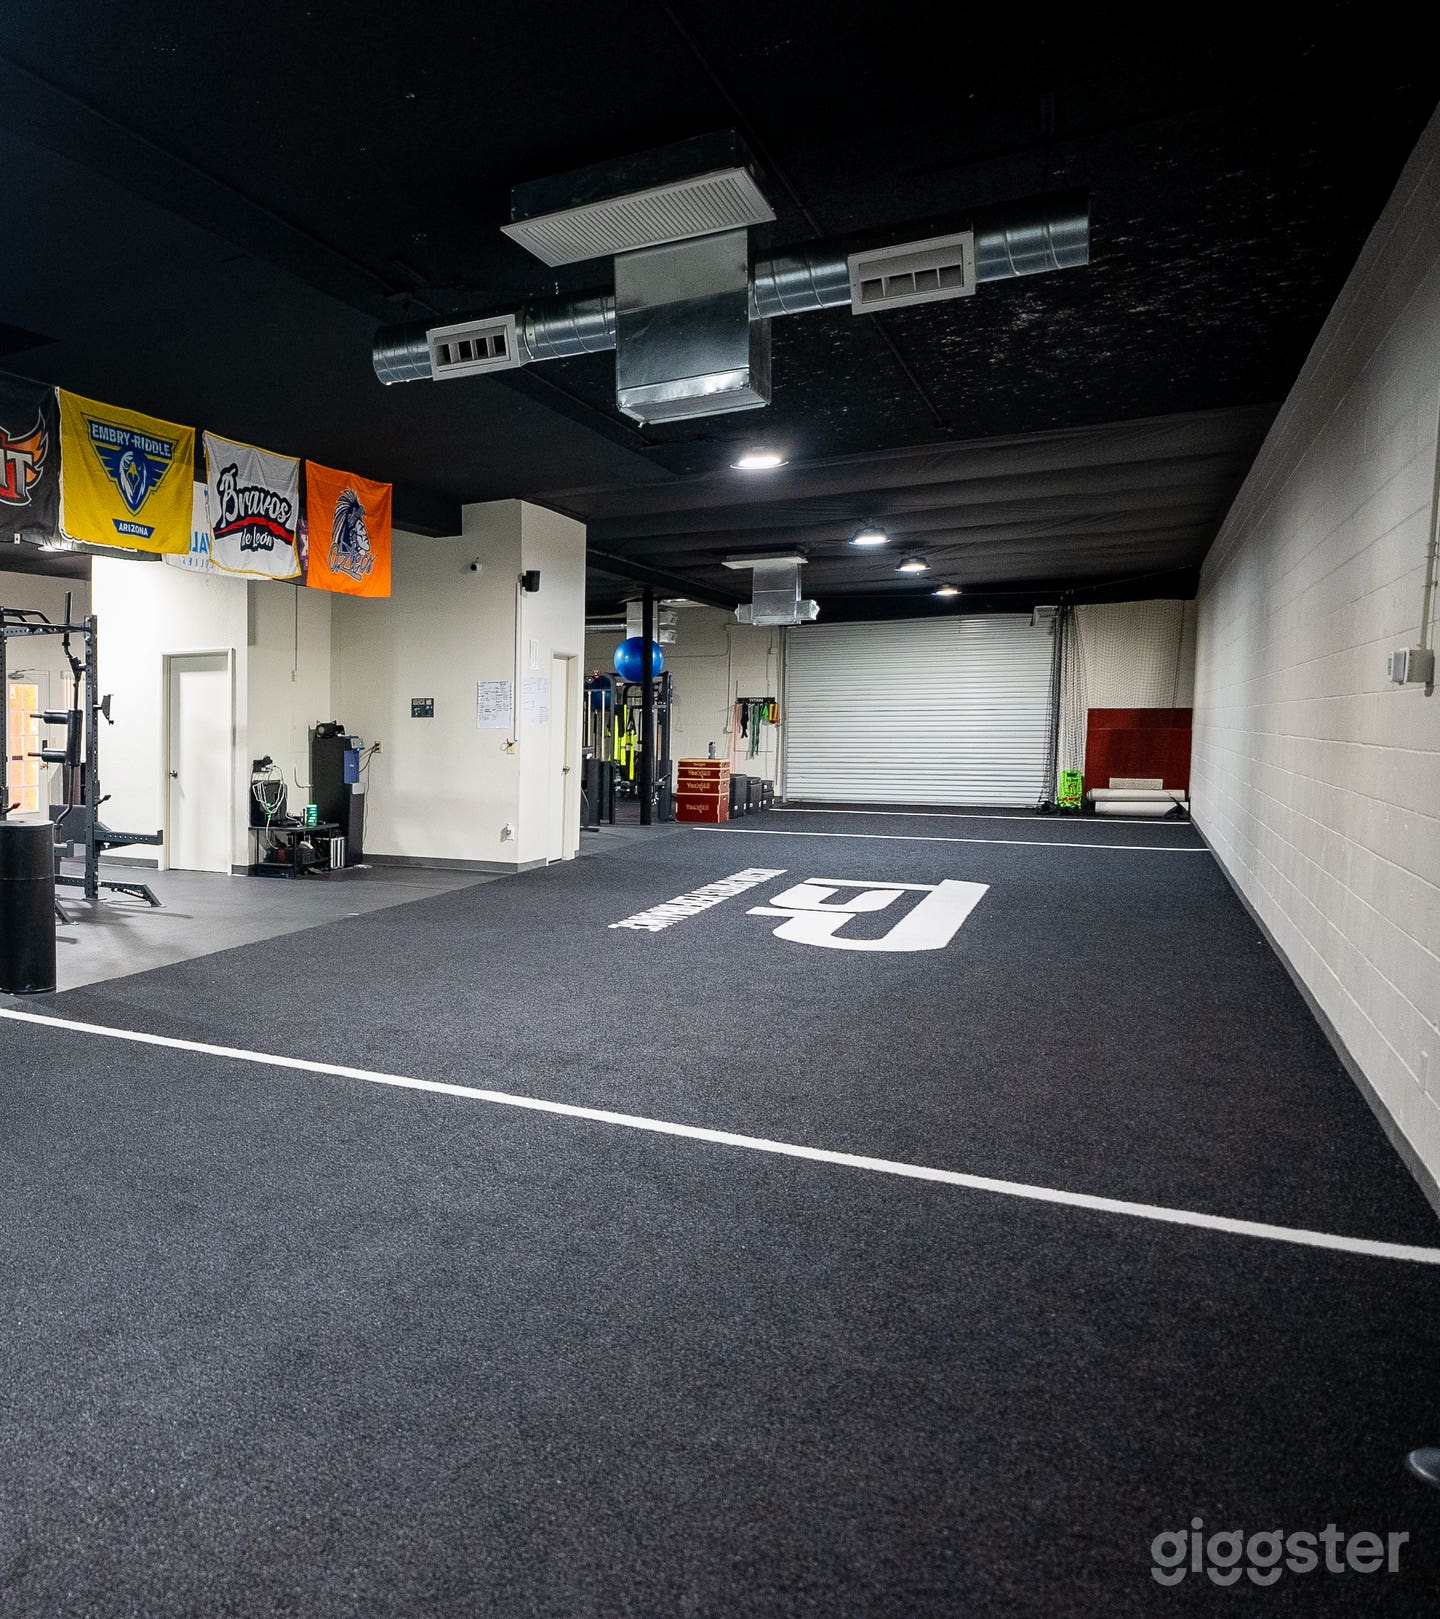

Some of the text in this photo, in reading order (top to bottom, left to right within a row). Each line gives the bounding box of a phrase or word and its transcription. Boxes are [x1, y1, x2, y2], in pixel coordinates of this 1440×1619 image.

[91, 423, 171, 457] EMBRY-RIDDLE
[219, 467, 291, 528] Bravos
[118, 523, 148, 536] ARIZONA
